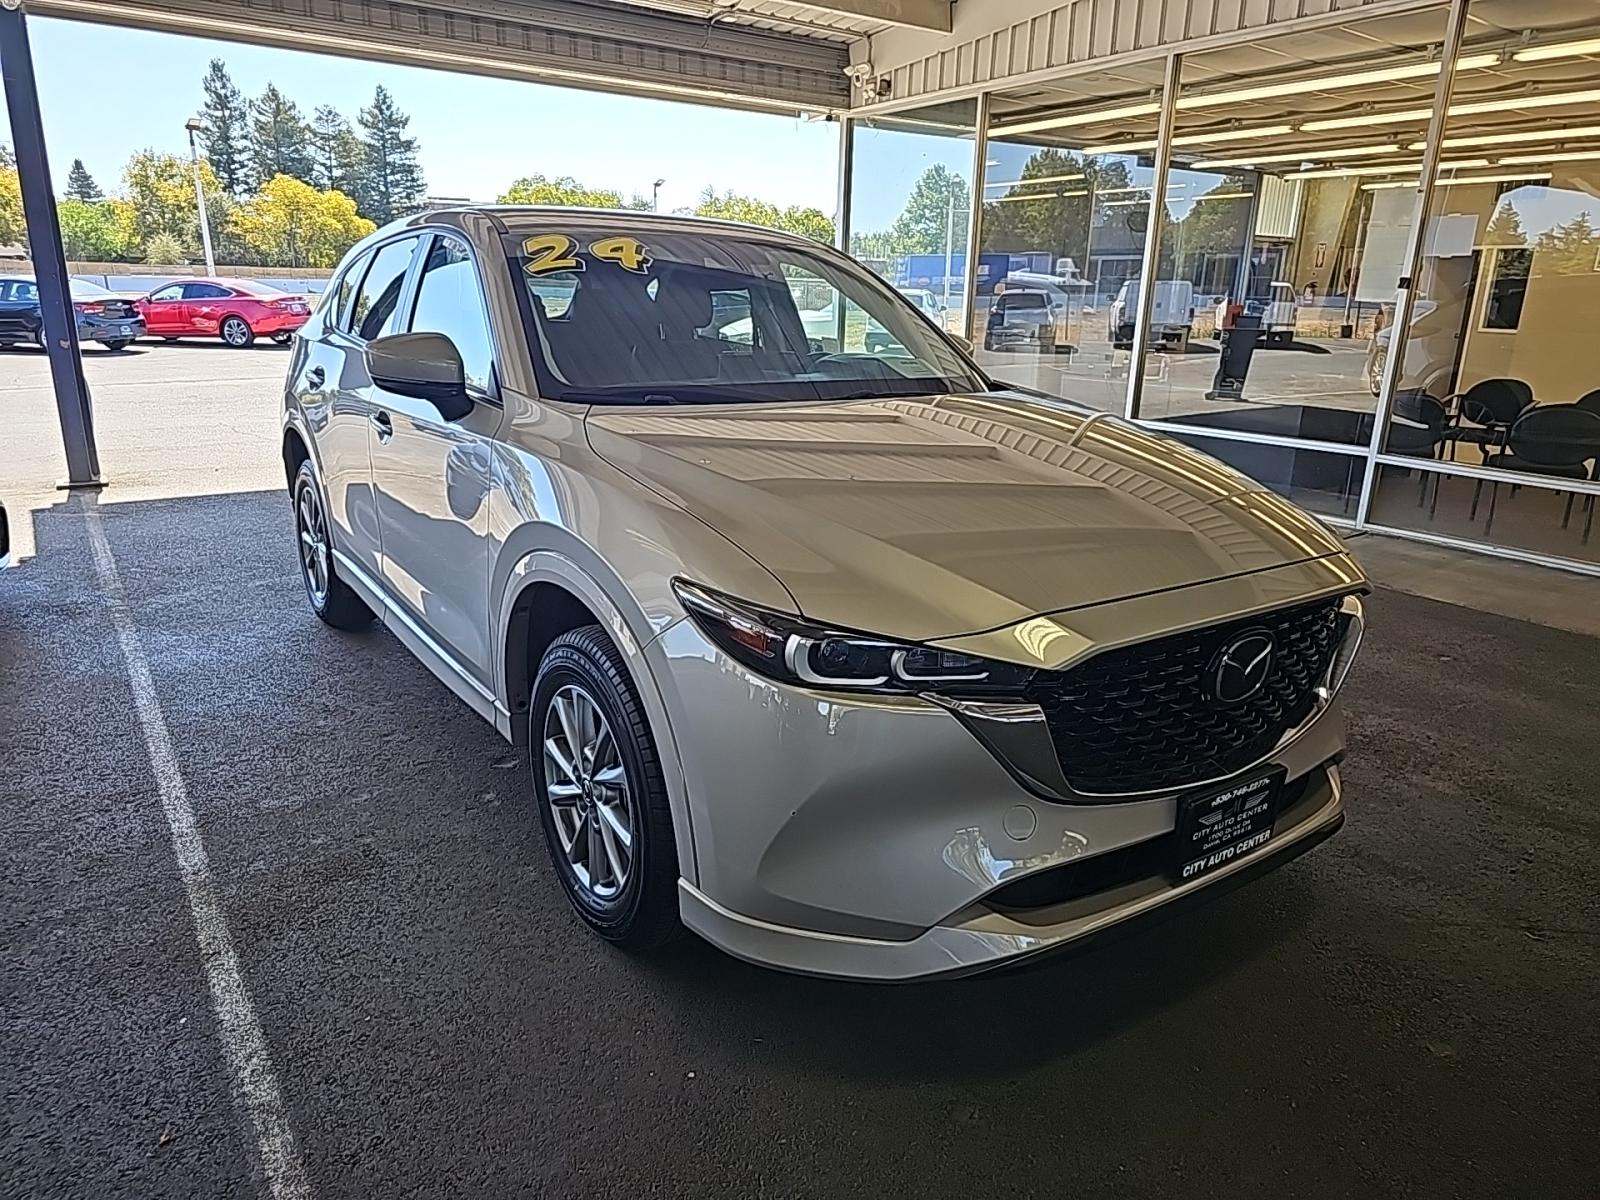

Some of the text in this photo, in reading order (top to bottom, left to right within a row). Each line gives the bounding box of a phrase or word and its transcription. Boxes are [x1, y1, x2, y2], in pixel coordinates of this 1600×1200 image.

[522, 232, 654, 277] 24
[1193, 803, 1268, 841] CITY AUTO CENTER
[1183, 829, 1271, 877] CITY AUTO CENTER
